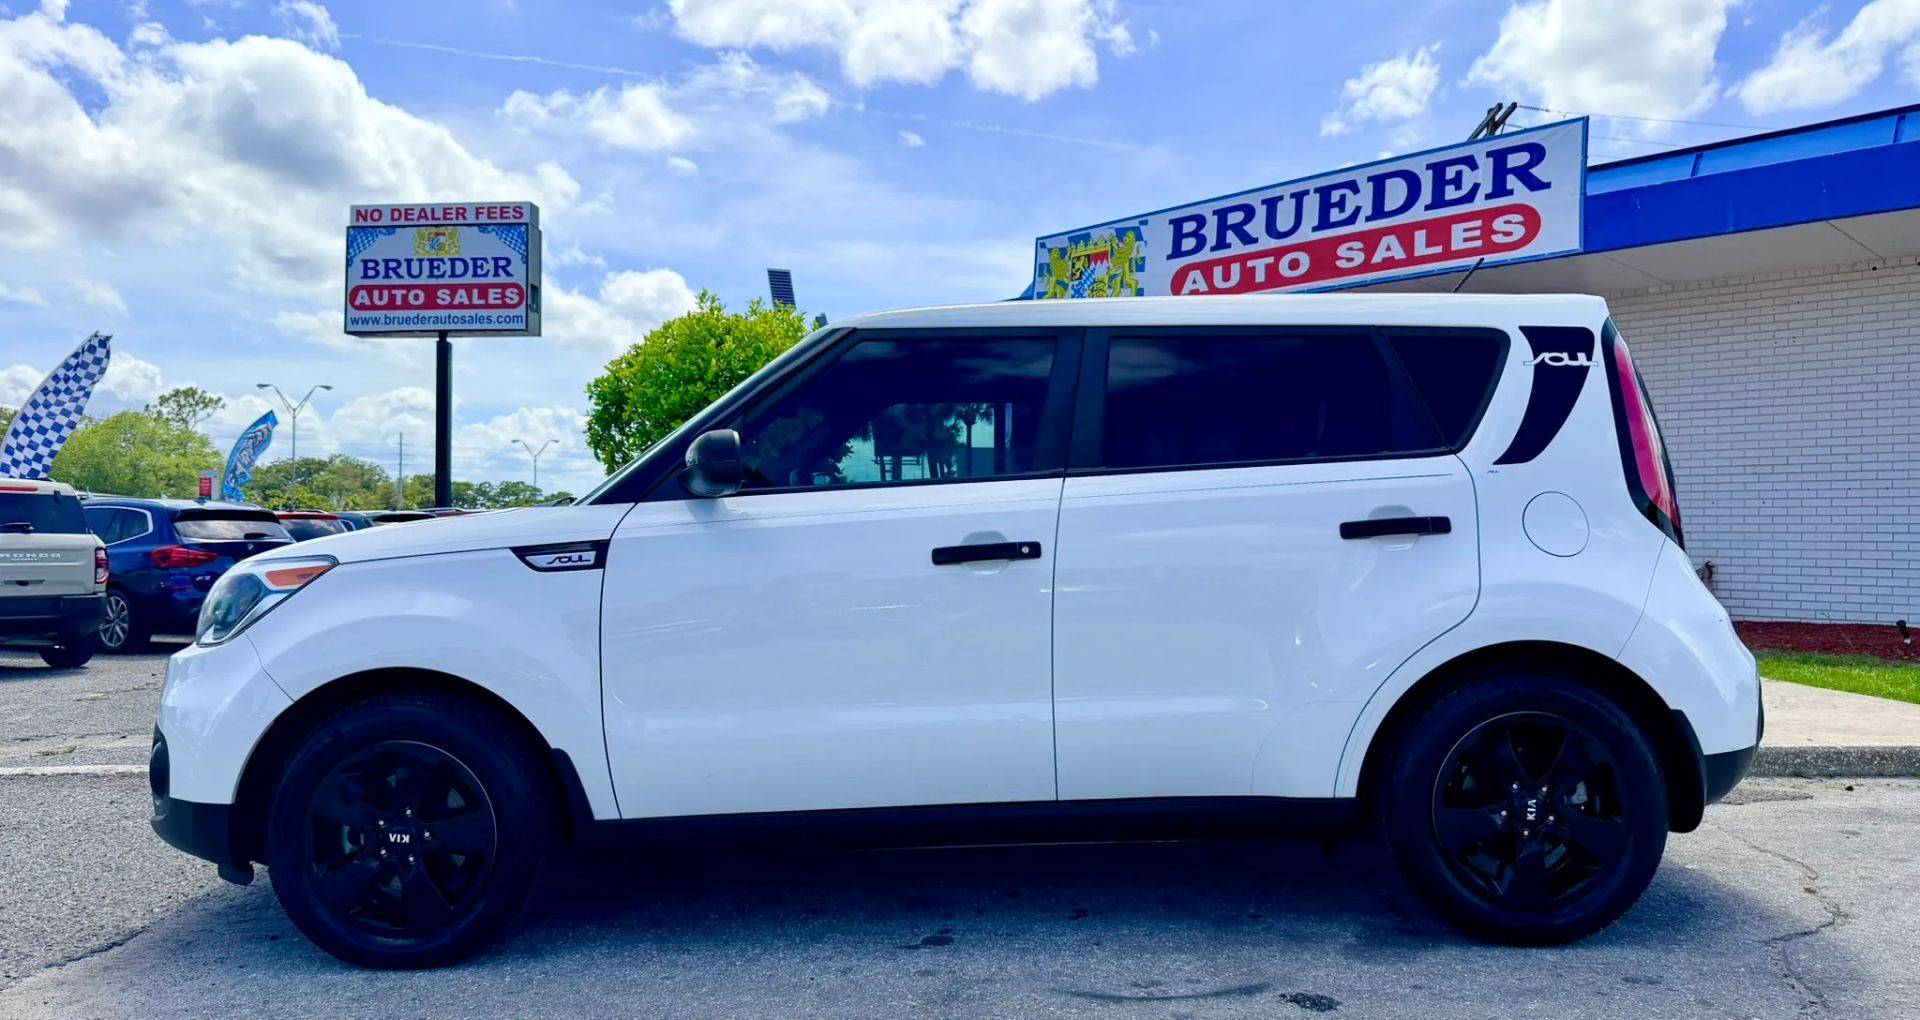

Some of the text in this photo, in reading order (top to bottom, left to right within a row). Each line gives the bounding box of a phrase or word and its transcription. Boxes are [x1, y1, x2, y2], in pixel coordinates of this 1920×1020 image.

[1166, 141, 1552, 260] BRUEDER
[355, 205, 524, 223] NO DEALER FEES
[1180, 213, 1526, 295] AUTO SALES
[360, 256, 514, 280] BRUEDER
[353, 287, 520, 306] AUTO SALES
[350, 312, 523, 327] www.bruederautosales.com
[1526, 799, 1537, 821] KIA
[389, 832, 410, 844] KIA
